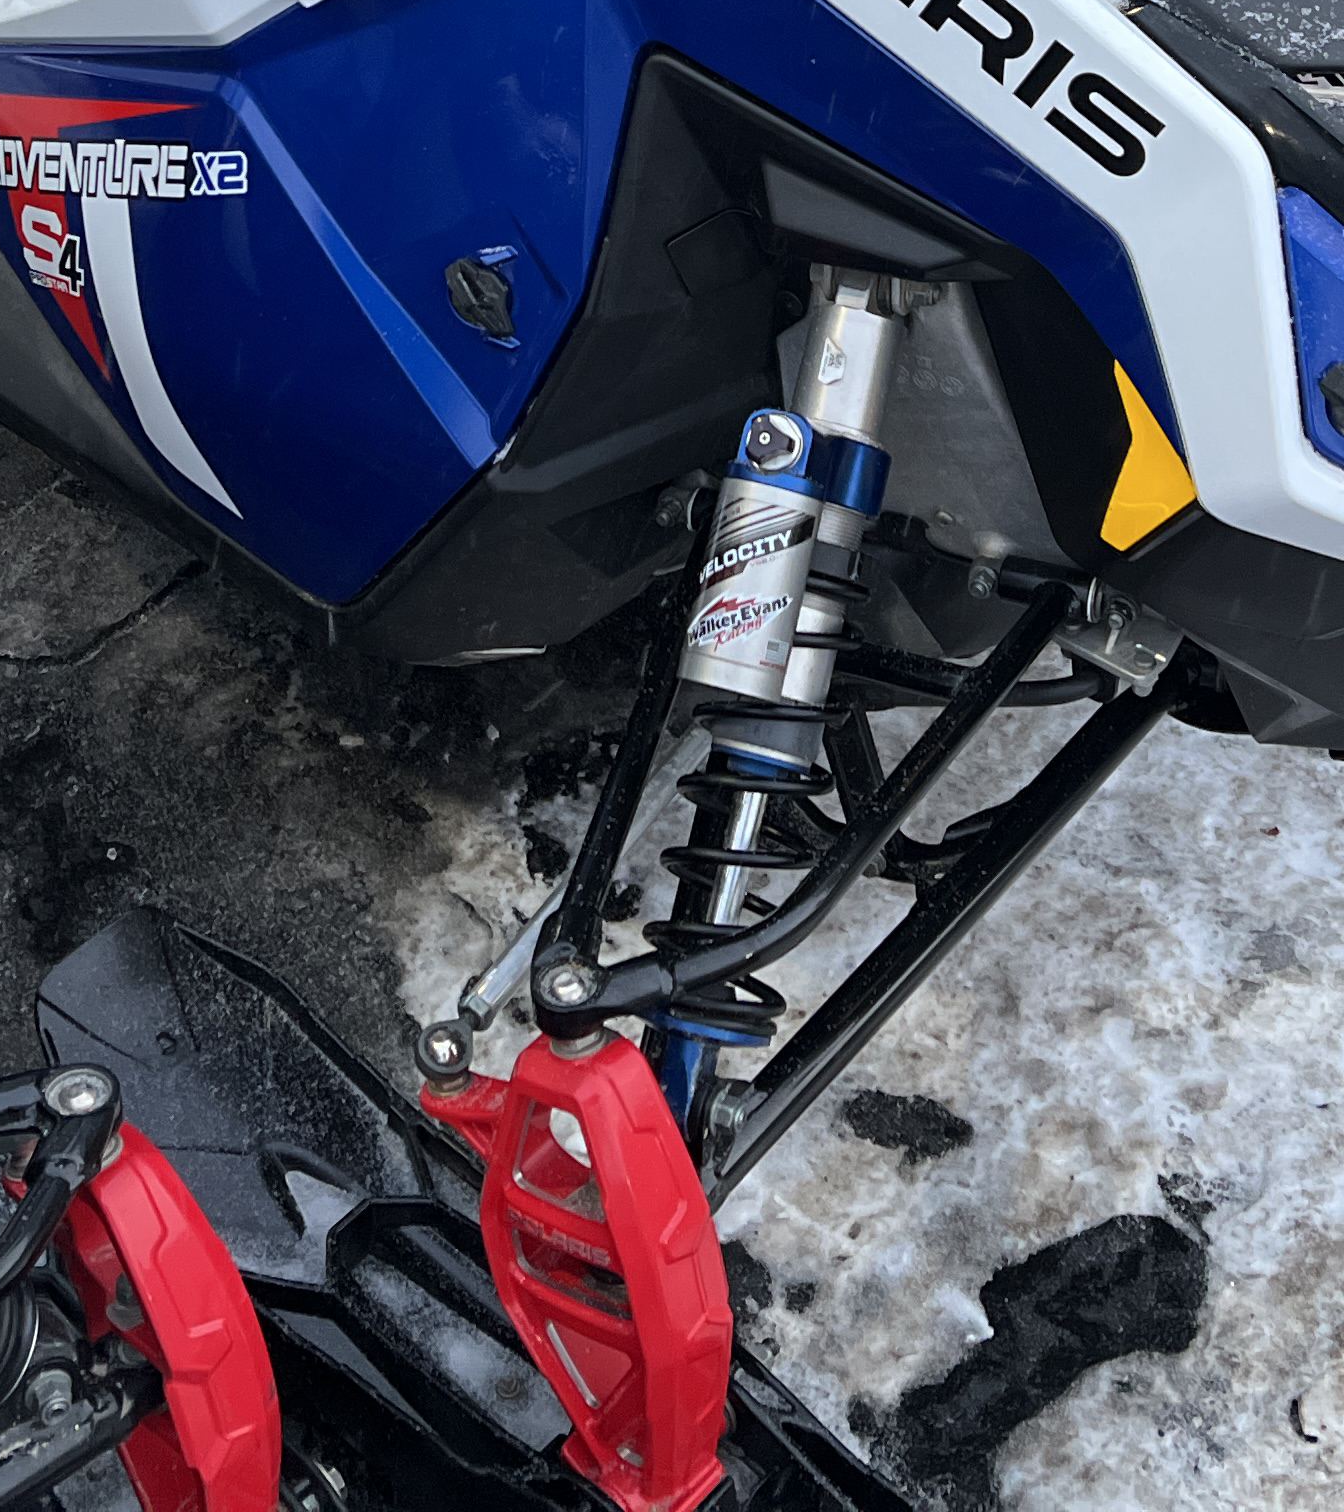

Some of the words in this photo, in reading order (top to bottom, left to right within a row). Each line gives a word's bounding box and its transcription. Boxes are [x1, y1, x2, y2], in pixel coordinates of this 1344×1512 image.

[190, 150, 248, 196] X2
[699, 530, 792, 584] VELOCITY
[740, 595, 789, 622] Evans
